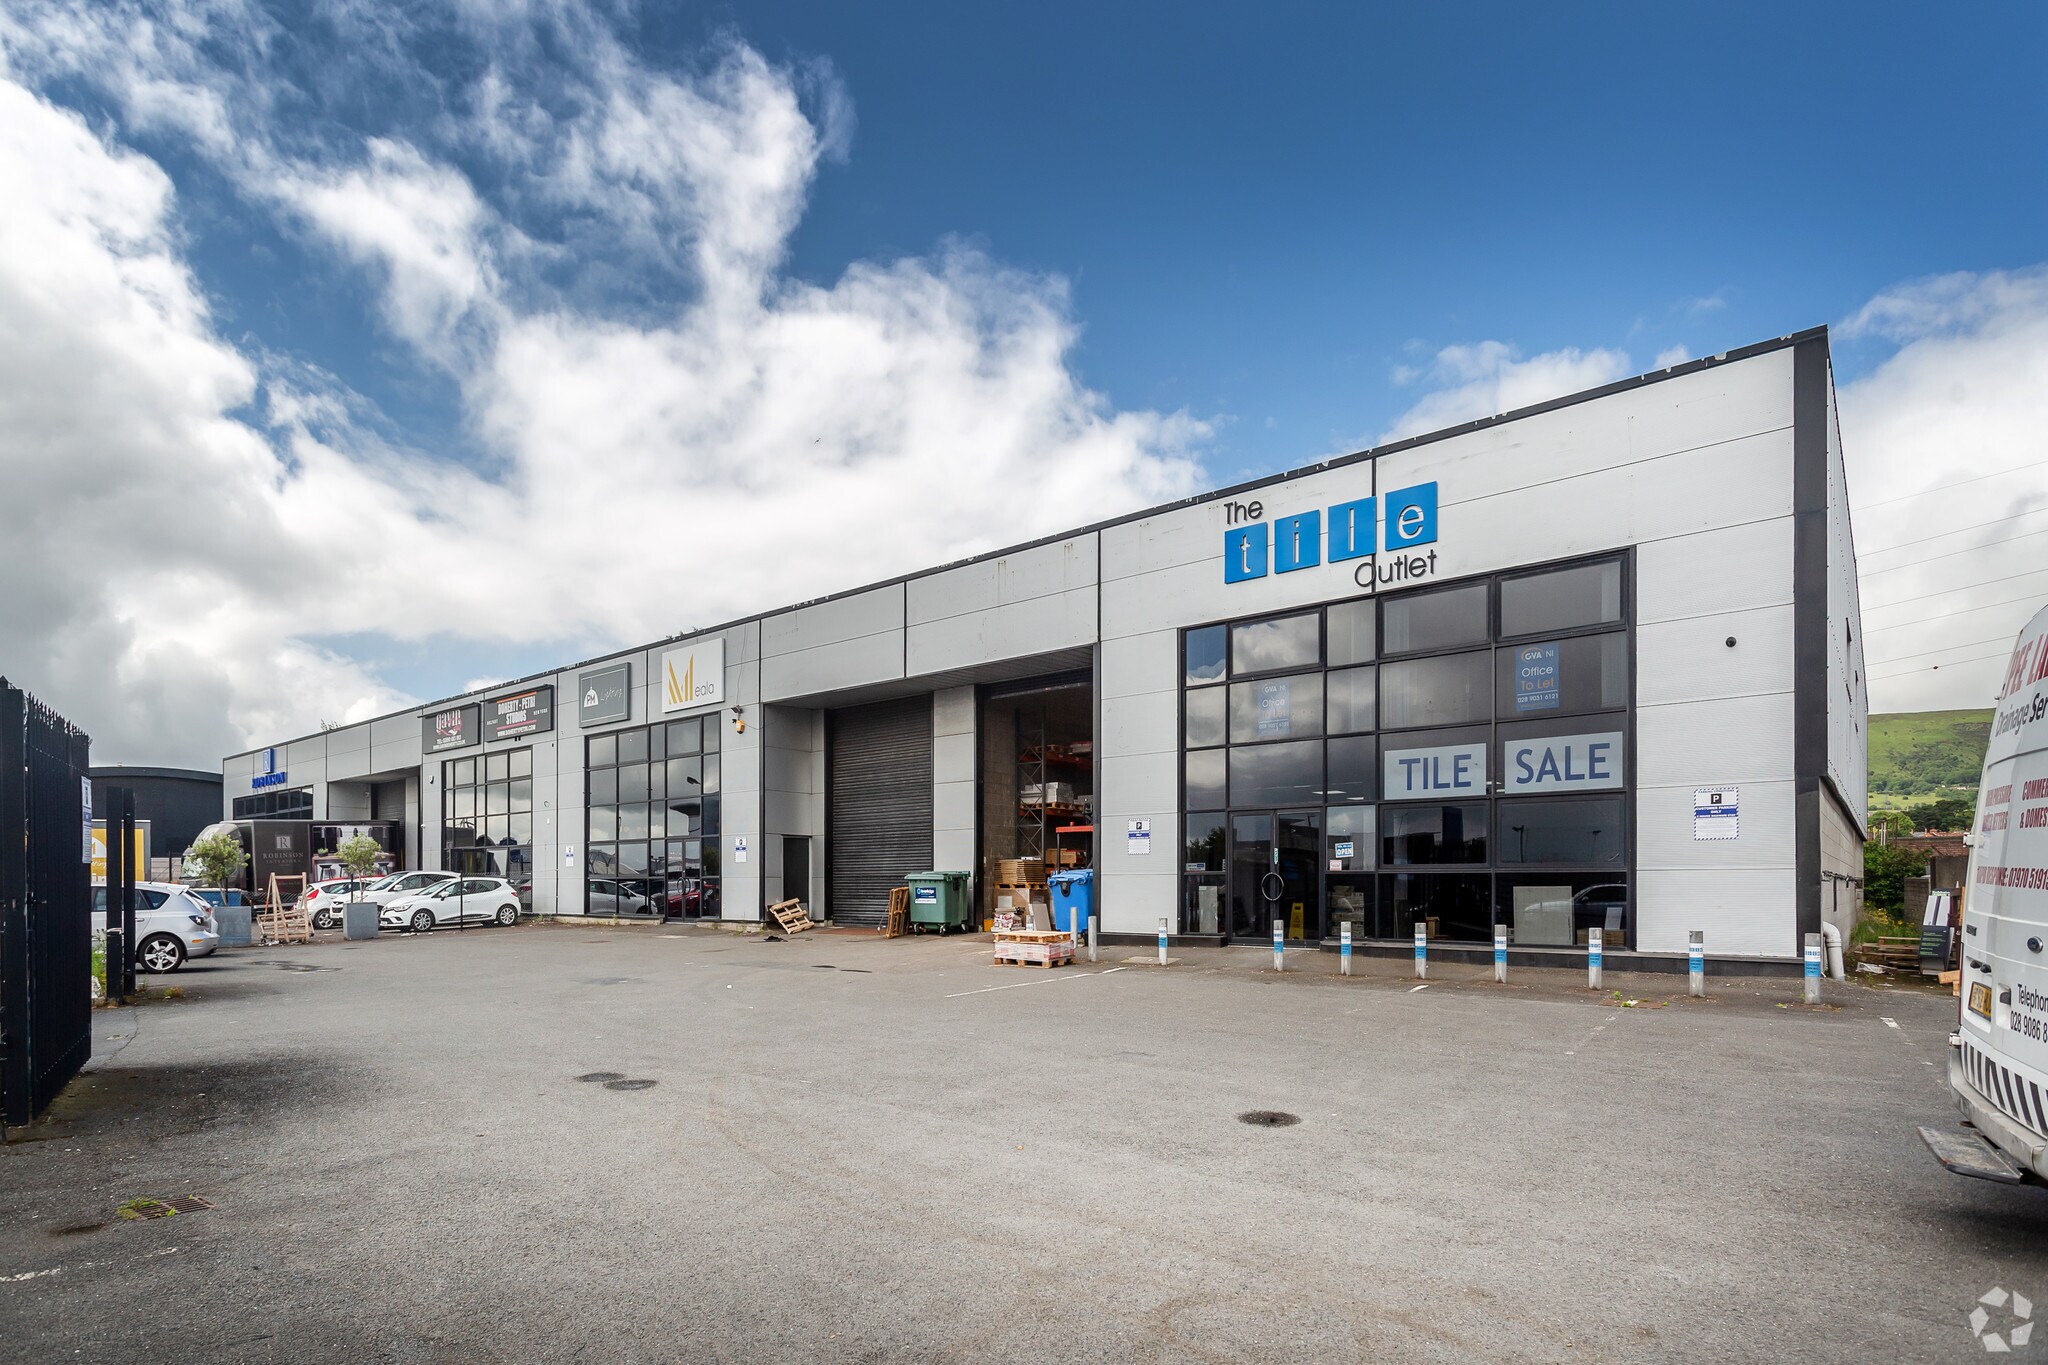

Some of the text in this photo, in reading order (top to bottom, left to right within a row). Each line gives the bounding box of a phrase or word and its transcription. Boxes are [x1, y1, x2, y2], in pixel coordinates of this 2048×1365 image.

[1224, 500, 1264, 526] The
[1236, 501, 1427, 576] tile
[1354, 549, 1437, 588] Outlet
[1524, 649, 1554, 661] GVA NI
[1521, 666, 1554, 678] Office
[1521, 677, 1555, 691] To Let
[1517, 696, 1529, 704] 028
[1544, 692, 1558, 701] 6121
[1399, 753, 1472, 791] TILE
[1516, 742, 1611, 785] SALE
[1713, 795, 1720, 803] P
[2025, 806, 2048, 829] DOMES
[1336, 848, 1352, 856] OPEN
[2008, 867, 2030, 888] 07970
[2010, 1010, 2048, 1044] 028 9086 8
